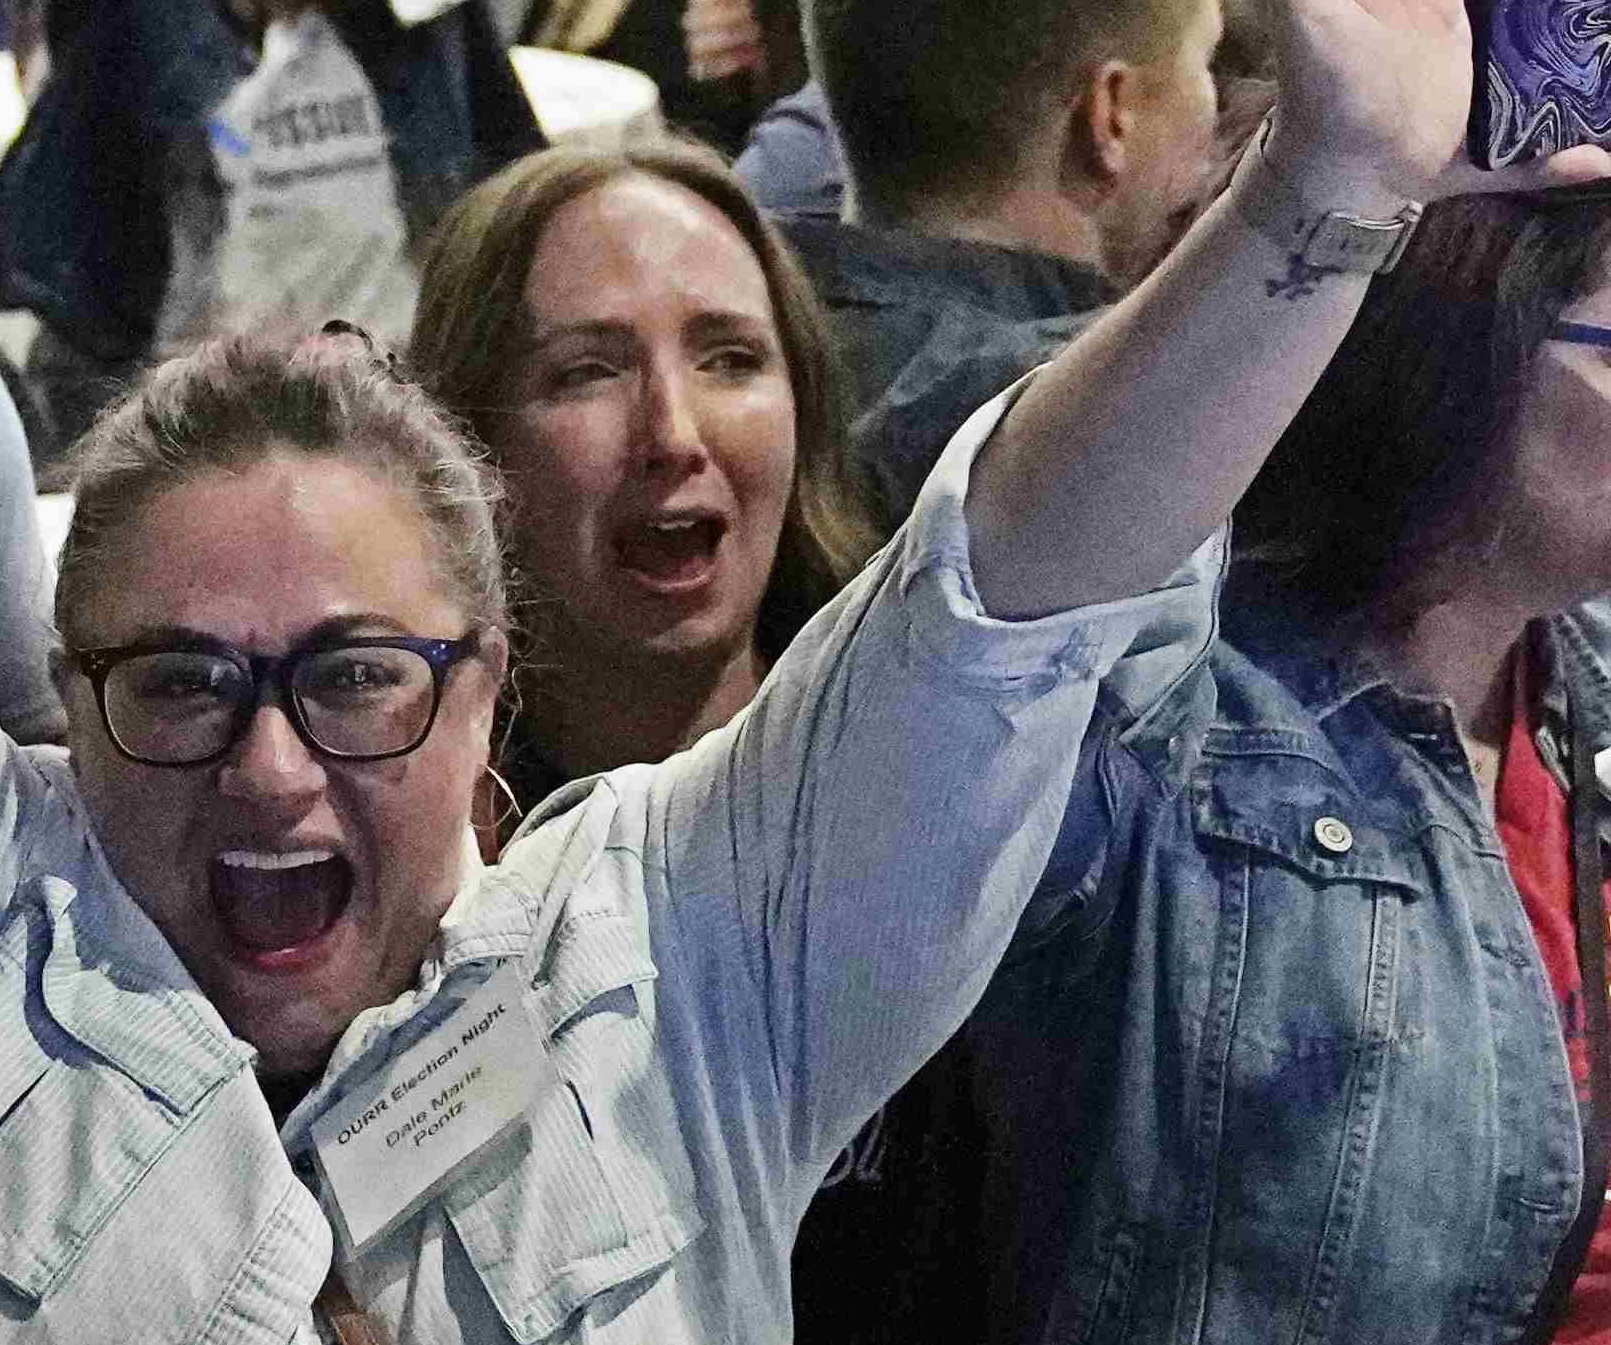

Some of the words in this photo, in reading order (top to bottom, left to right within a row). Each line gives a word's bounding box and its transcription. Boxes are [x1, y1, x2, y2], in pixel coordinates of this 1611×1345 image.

[337, 1099, 388, 1145] OURR
[391, 1045, 459, 1102] Election
[461, 1003, 507, 1046] Night
[385, 1109, 428, 1148] Dale
[431, 1066, 483, 1111] Marie
